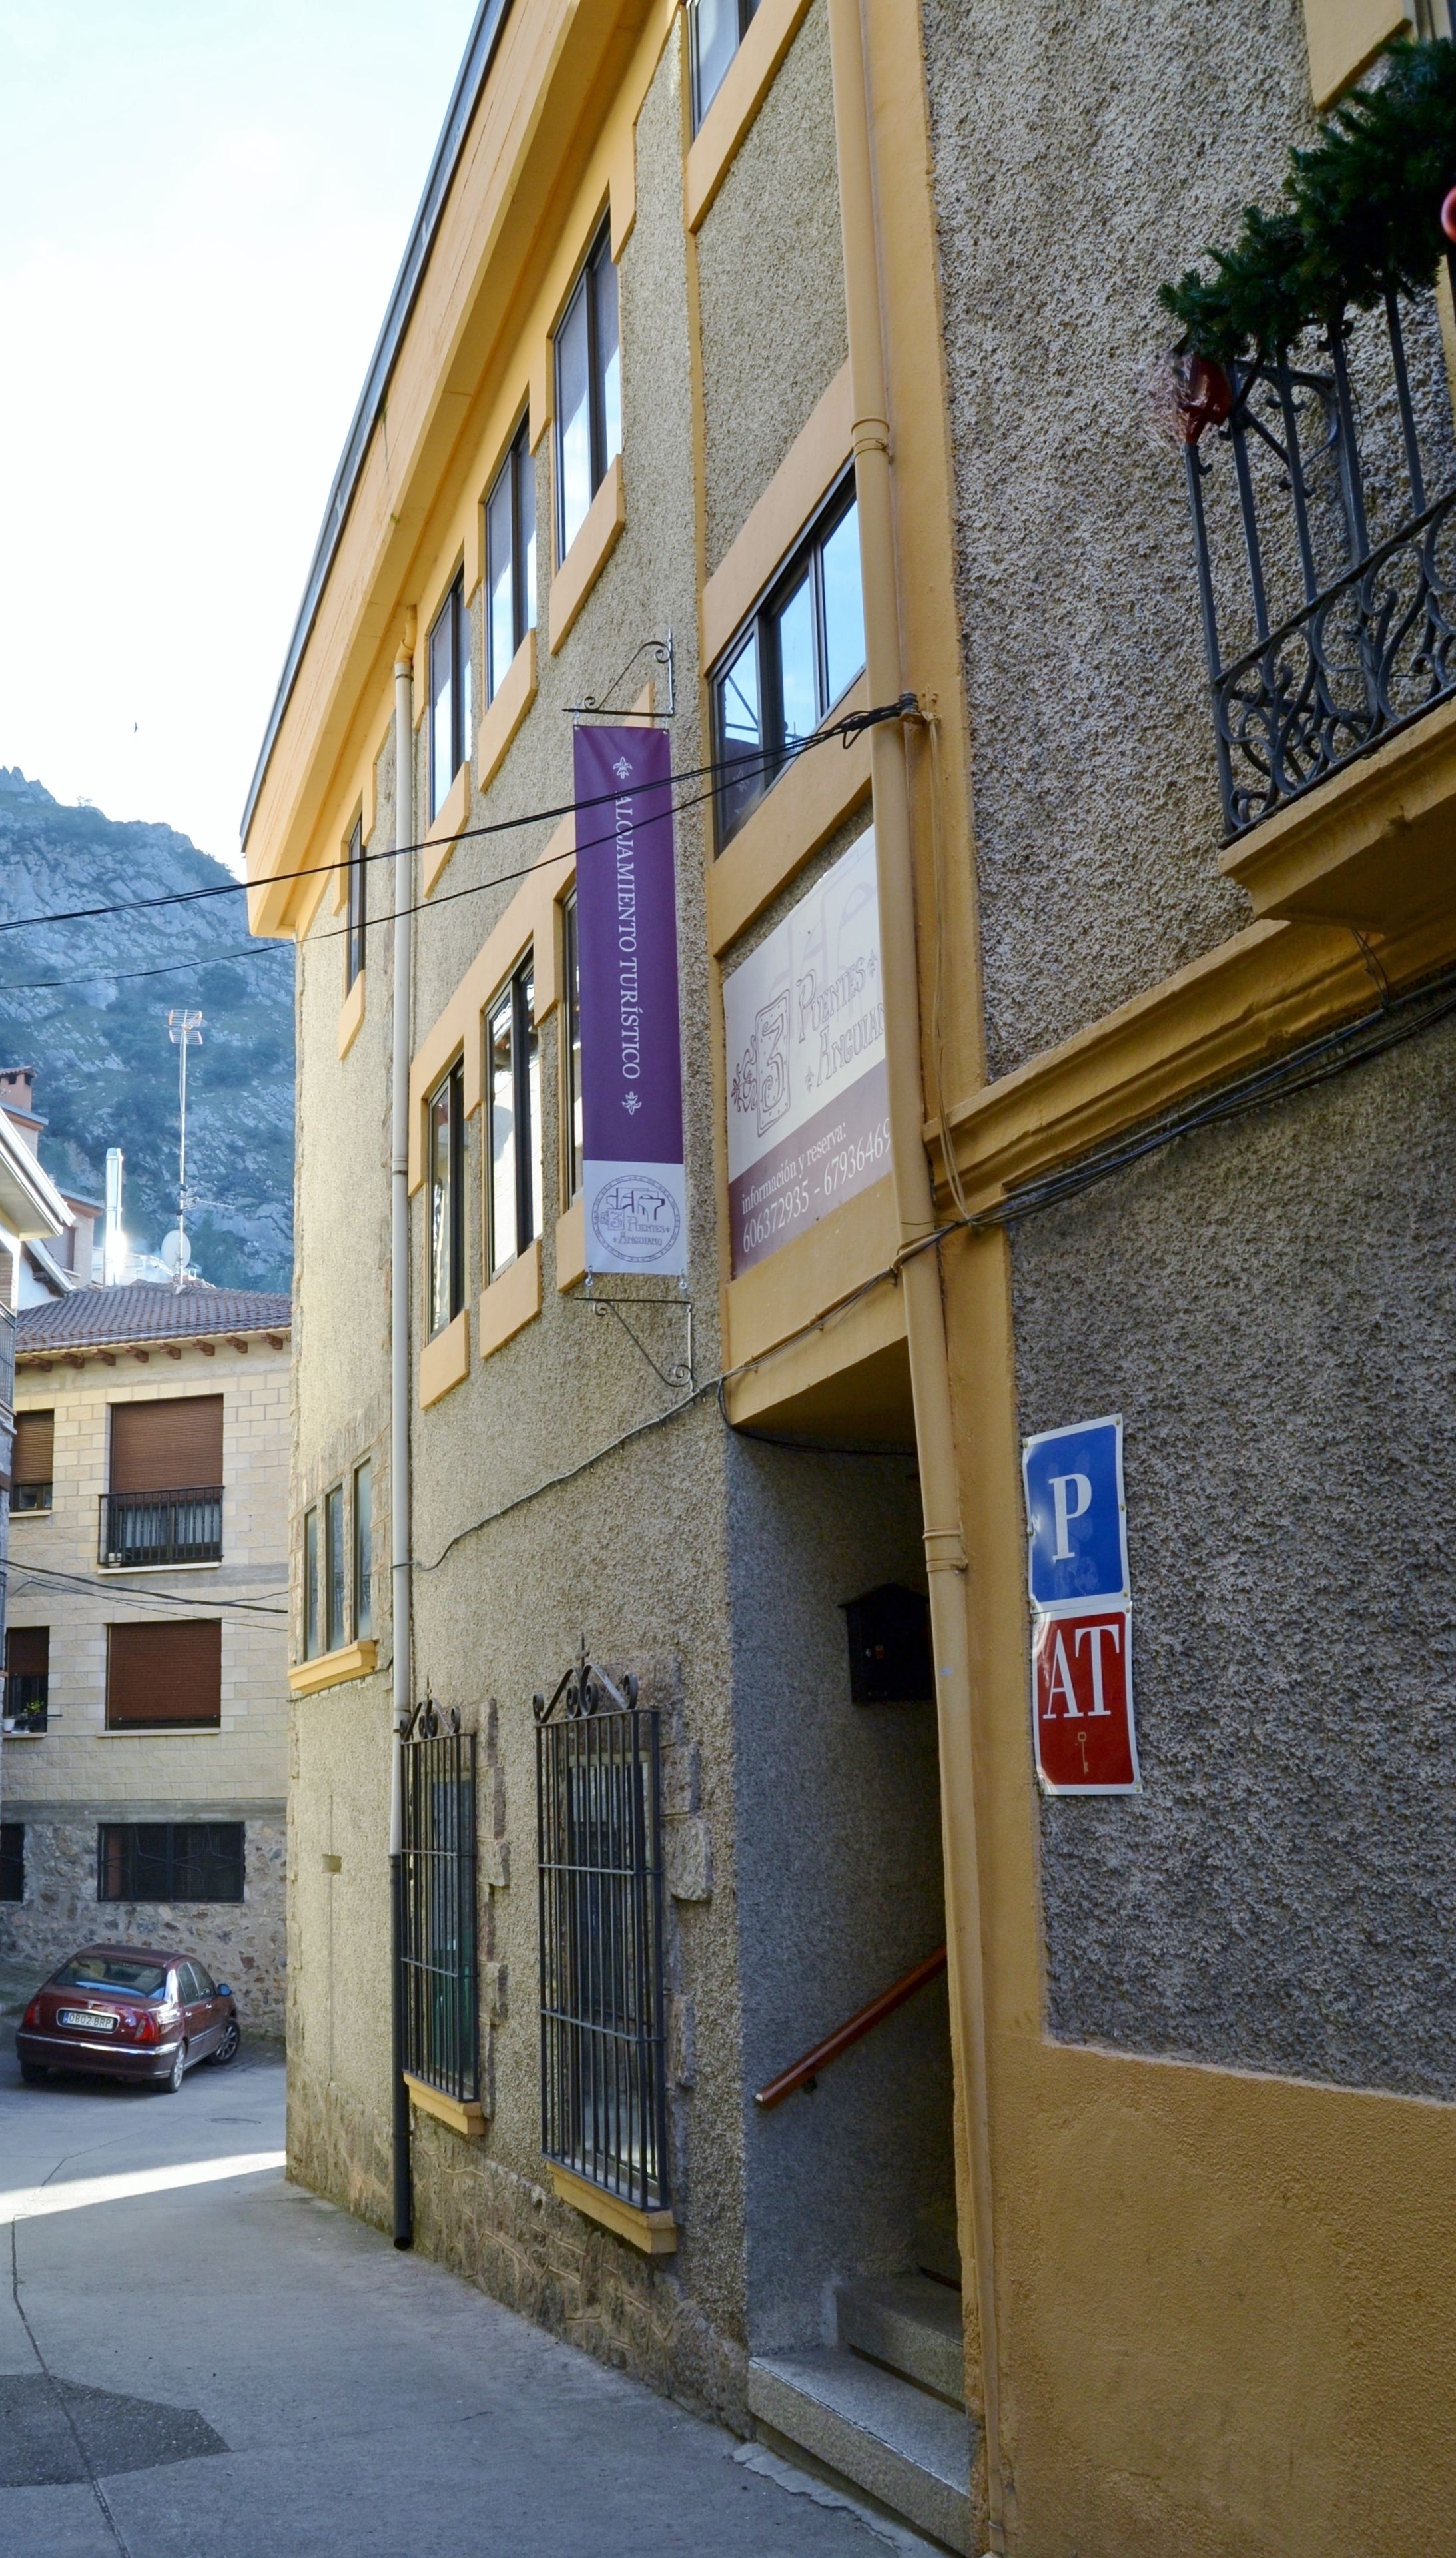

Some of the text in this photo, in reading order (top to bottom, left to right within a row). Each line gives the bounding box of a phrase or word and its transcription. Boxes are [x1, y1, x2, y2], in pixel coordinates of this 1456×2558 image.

[615, 791, 643, 1079] ALOJAMIENTO TURÍSTICO
[762, 957, 865, 1112] 3 PUENTES
[742, 1122, 847, 1214] información y reserva:
[743, 1177, 809, 1252] 606372935
[1048, 1473, 1092, 1560] P
[1042, 1624, 1120, 1719] AT
